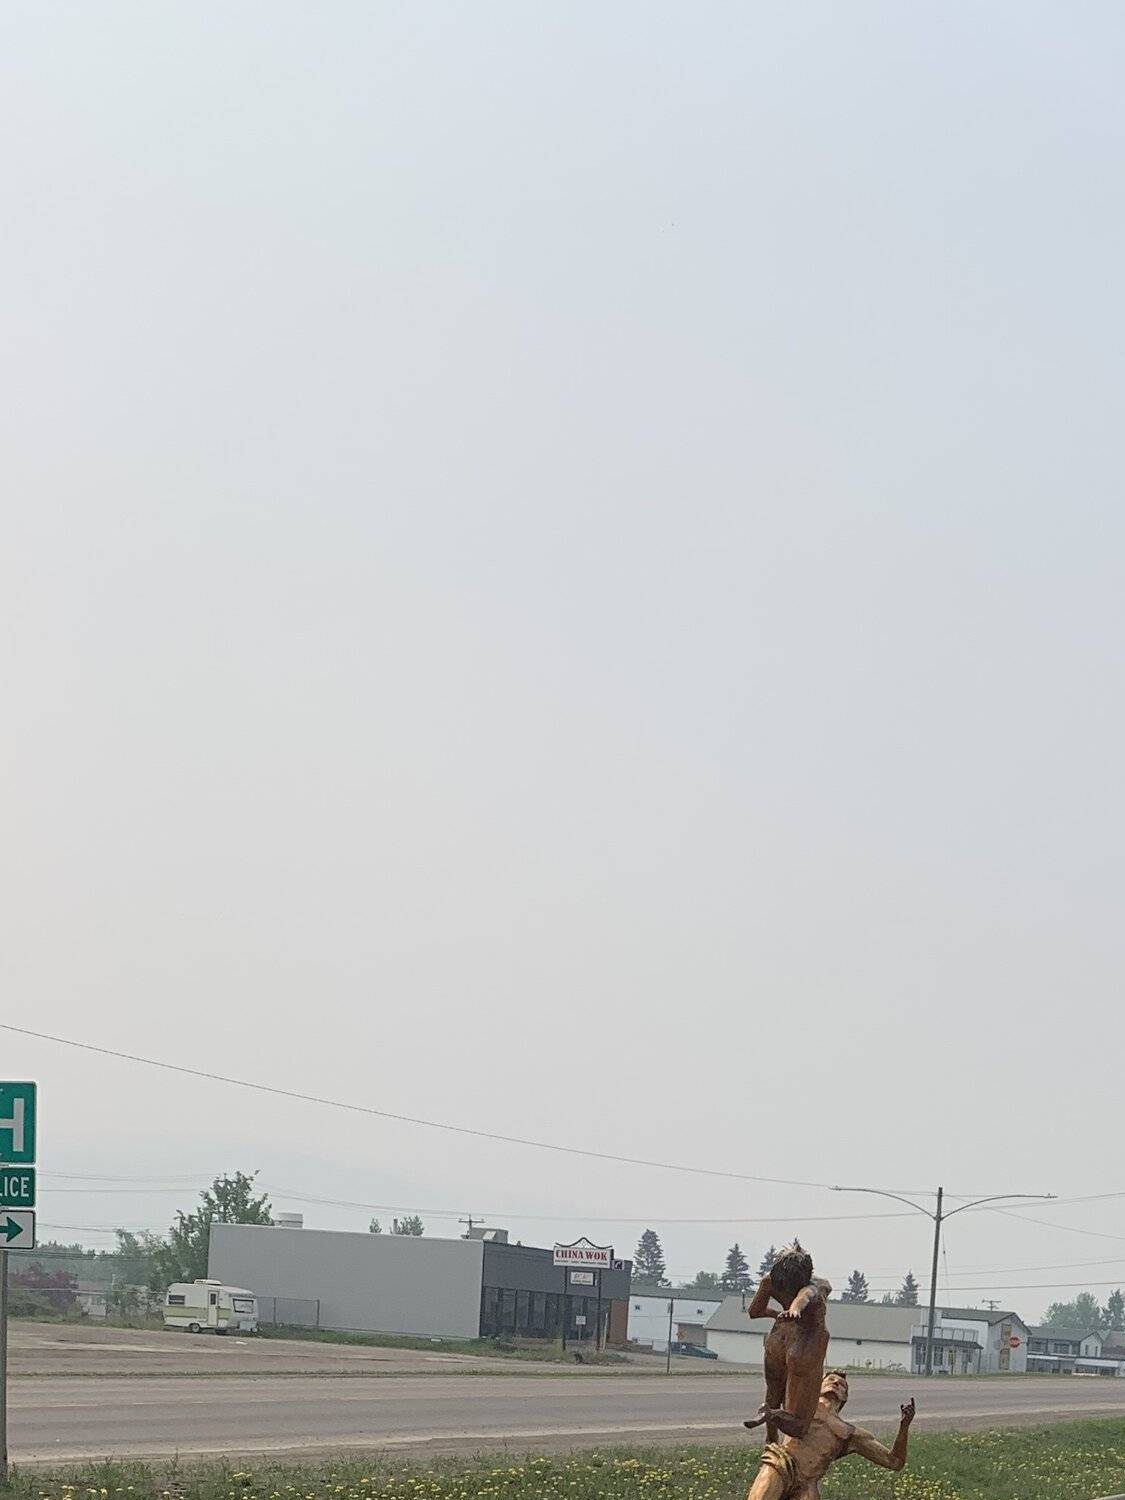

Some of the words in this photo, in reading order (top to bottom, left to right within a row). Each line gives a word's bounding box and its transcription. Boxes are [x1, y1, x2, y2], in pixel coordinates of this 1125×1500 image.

[0, 1176, 30, 1197] ICE
[556, 1250, 584, 1259] CHINA
[586, 1251, 608, 1261] WOK
